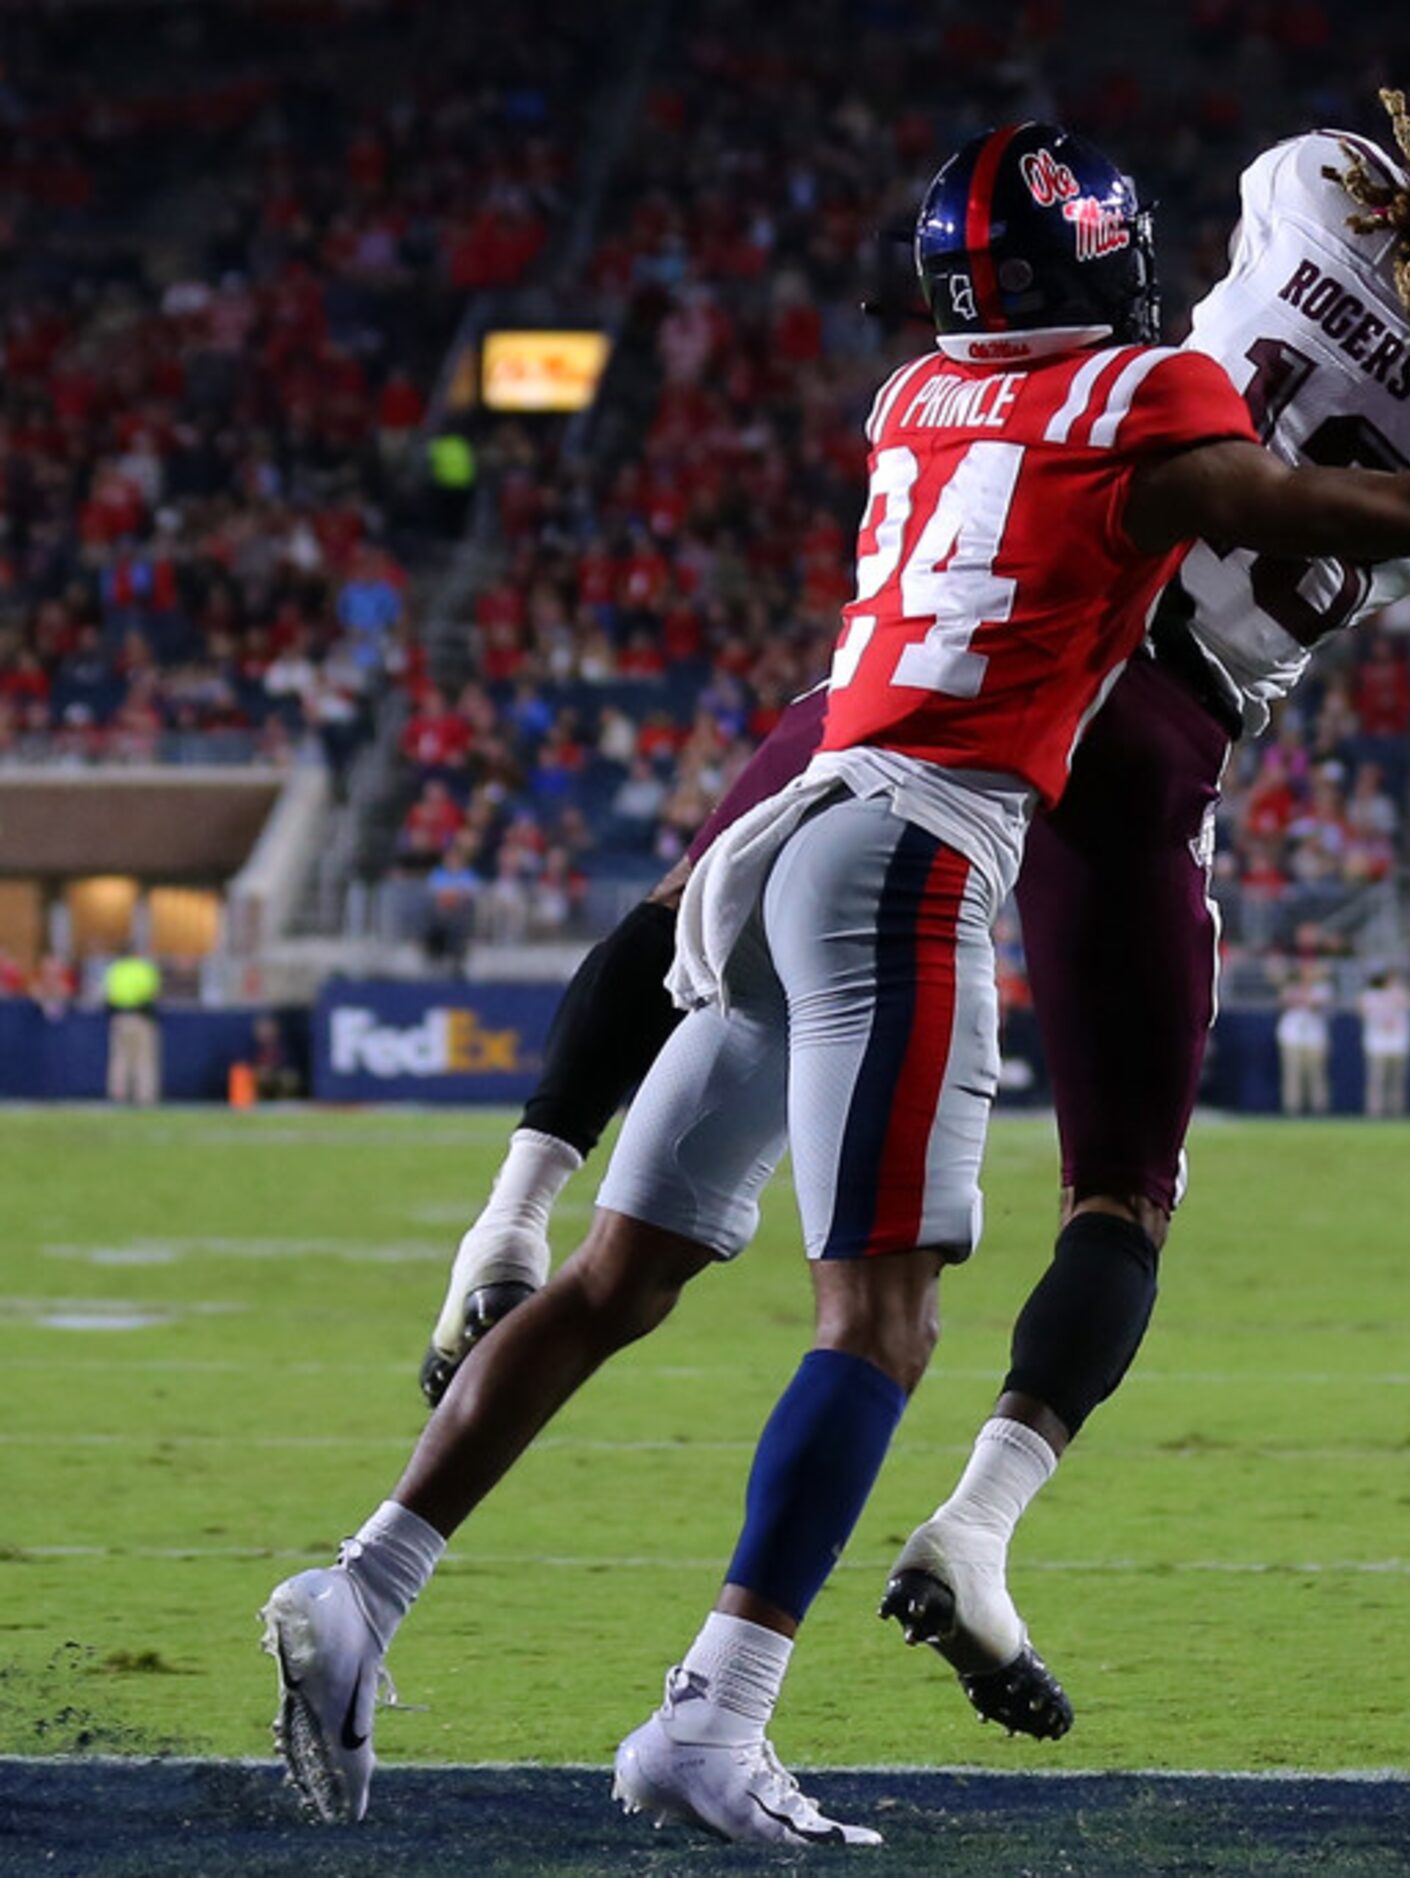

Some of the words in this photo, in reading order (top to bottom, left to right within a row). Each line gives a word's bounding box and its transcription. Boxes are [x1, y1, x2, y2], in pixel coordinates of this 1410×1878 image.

[1019, 148, 1080, 207] Ole
[900, 371, 1028, 428] PRINCE
[828, 439, 1026, 699] 24
[331, 1008, 520, 1078] FedEx
